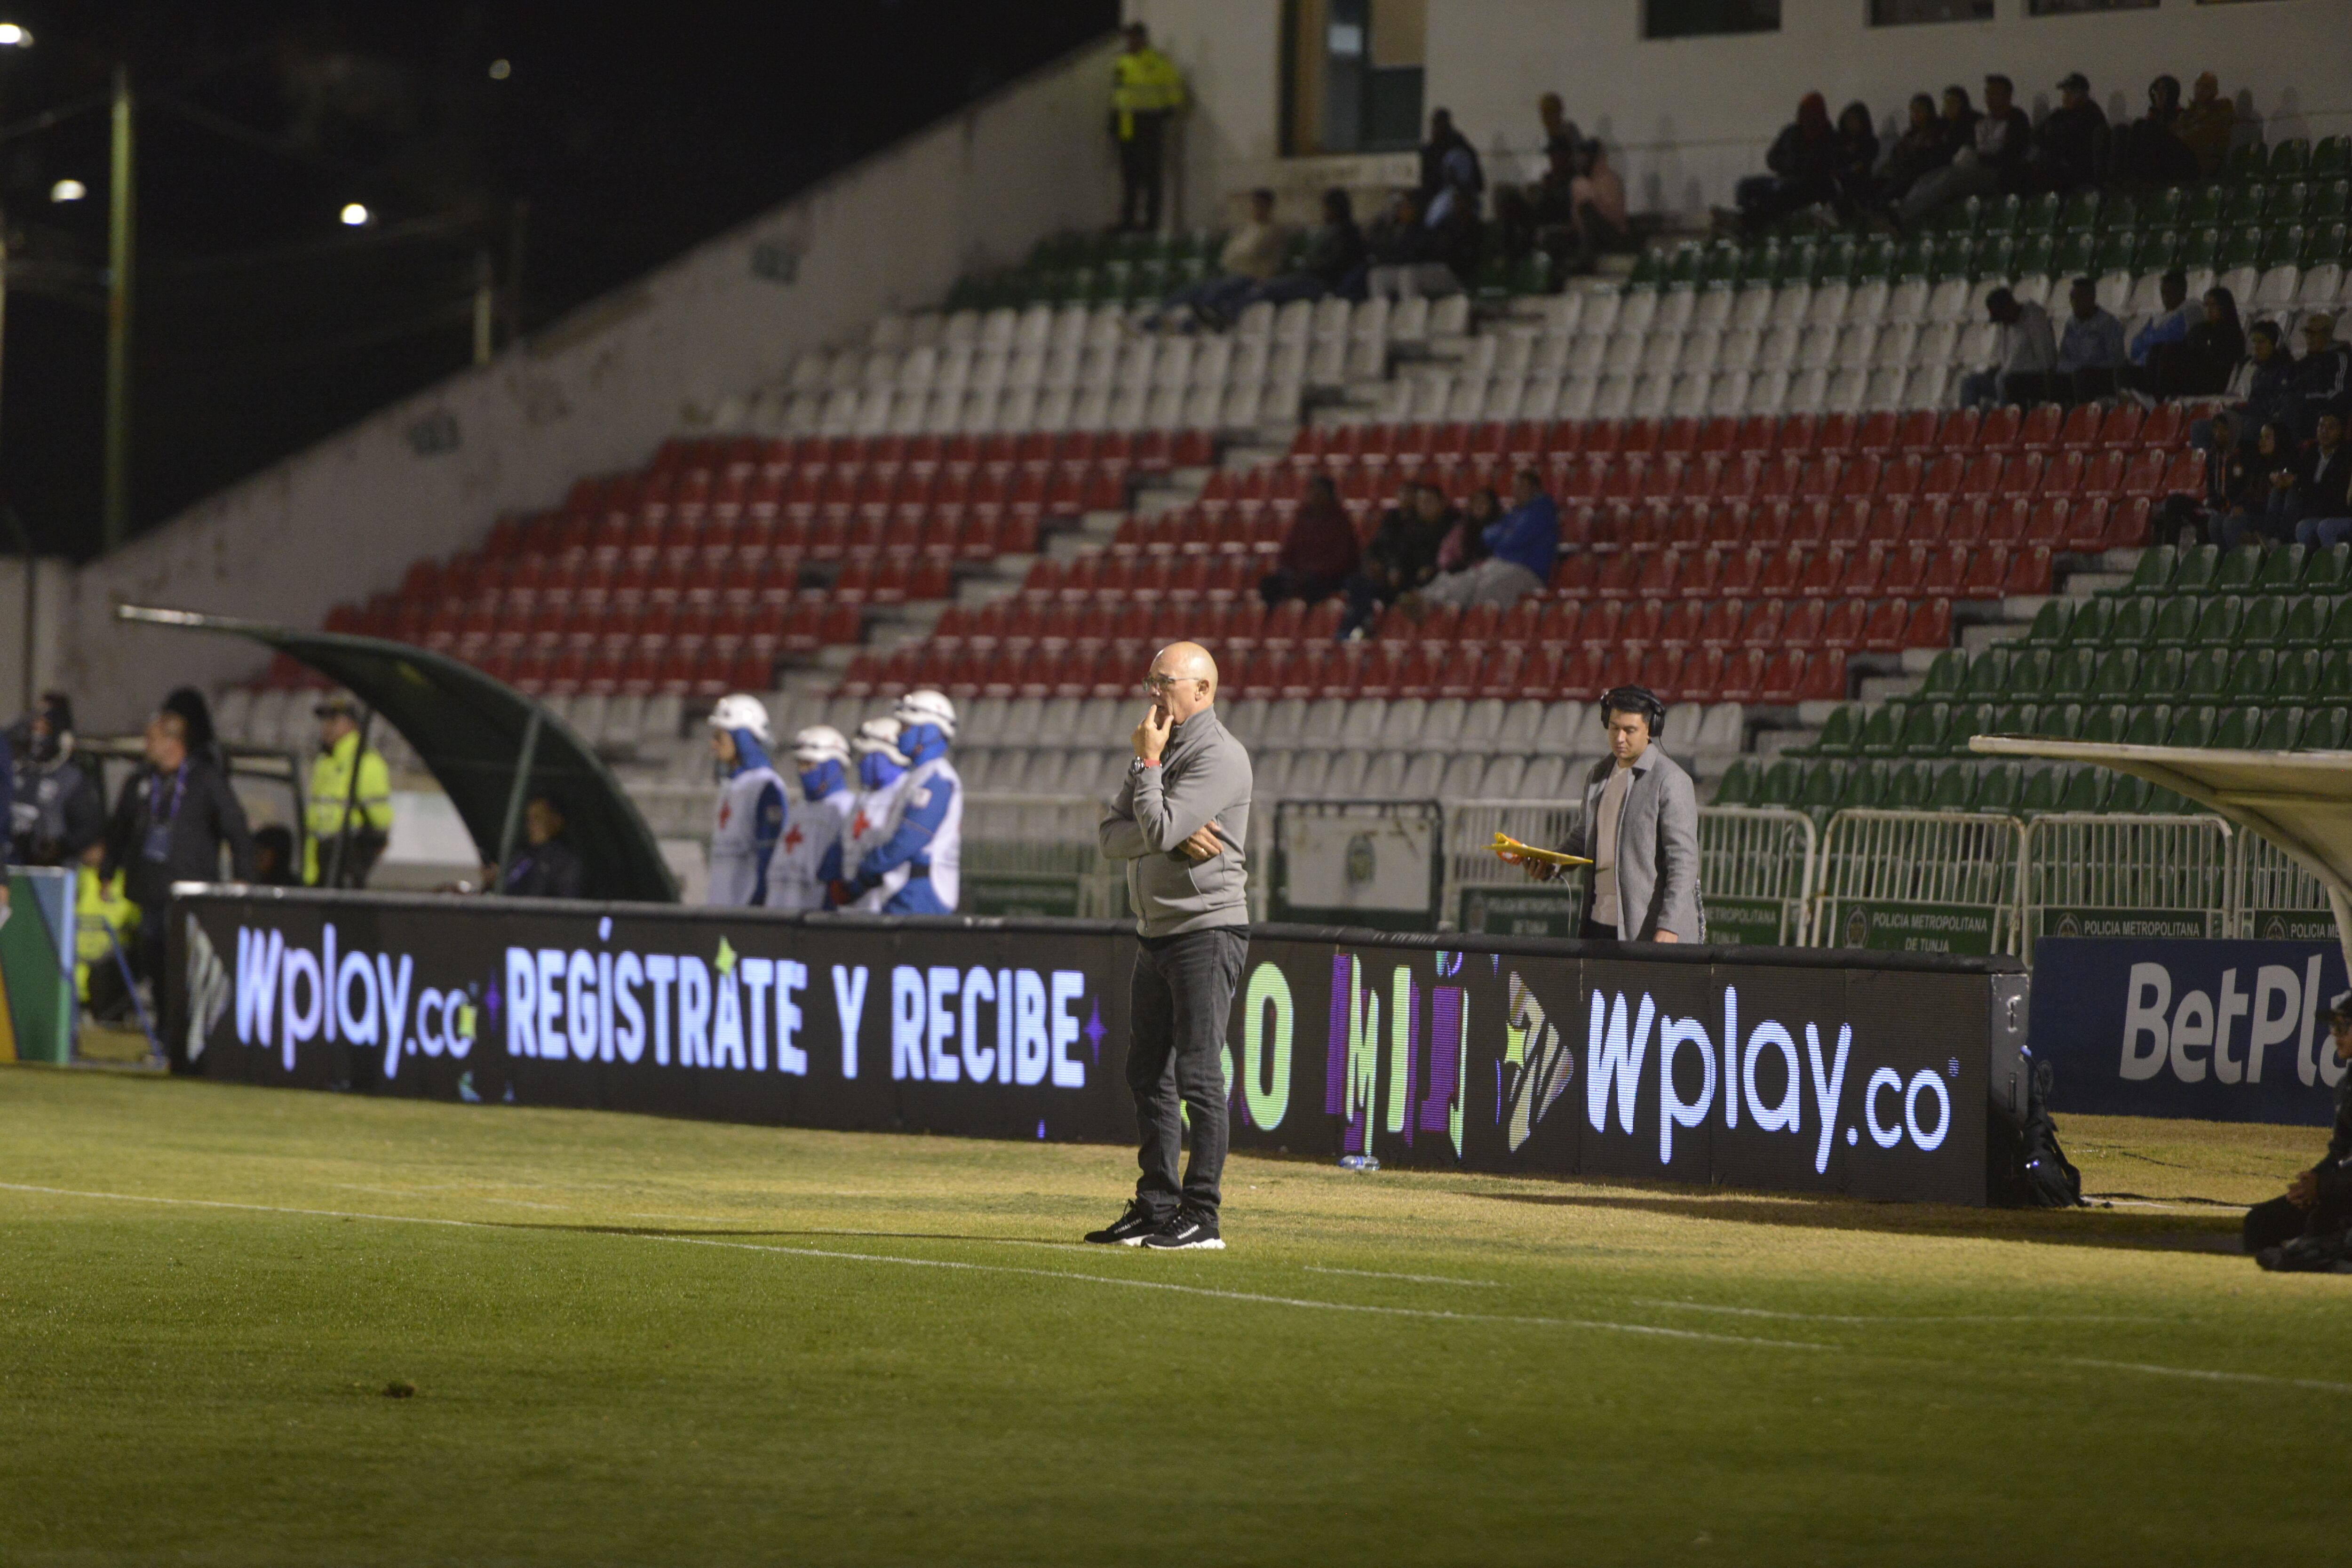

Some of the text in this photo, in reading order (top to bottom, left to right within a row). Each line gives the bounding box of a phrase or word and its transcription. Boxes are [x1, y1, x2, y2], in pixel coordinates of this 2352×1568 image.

[1873, 912, 1987, 932] POLICIA METROPOLITANA
[2084, 920, 2200, 937] POLICIA METROPOLITANA
[2291, 923, 2326, 938] POLICIA
[1906, 937, 1949, 953] DE TUNJA
[236, 923, 472, 1079] Wplay.co
[831, 963, 868, 1079] Y
[892, 964, 1085, 1088] RECIBE
[1587, 984, 1951, 1174] Wplay.co
[1114, 1218, 1142, 1234] MONASTERY
[1177, 1224, 1200, 1240] MONASTERY
